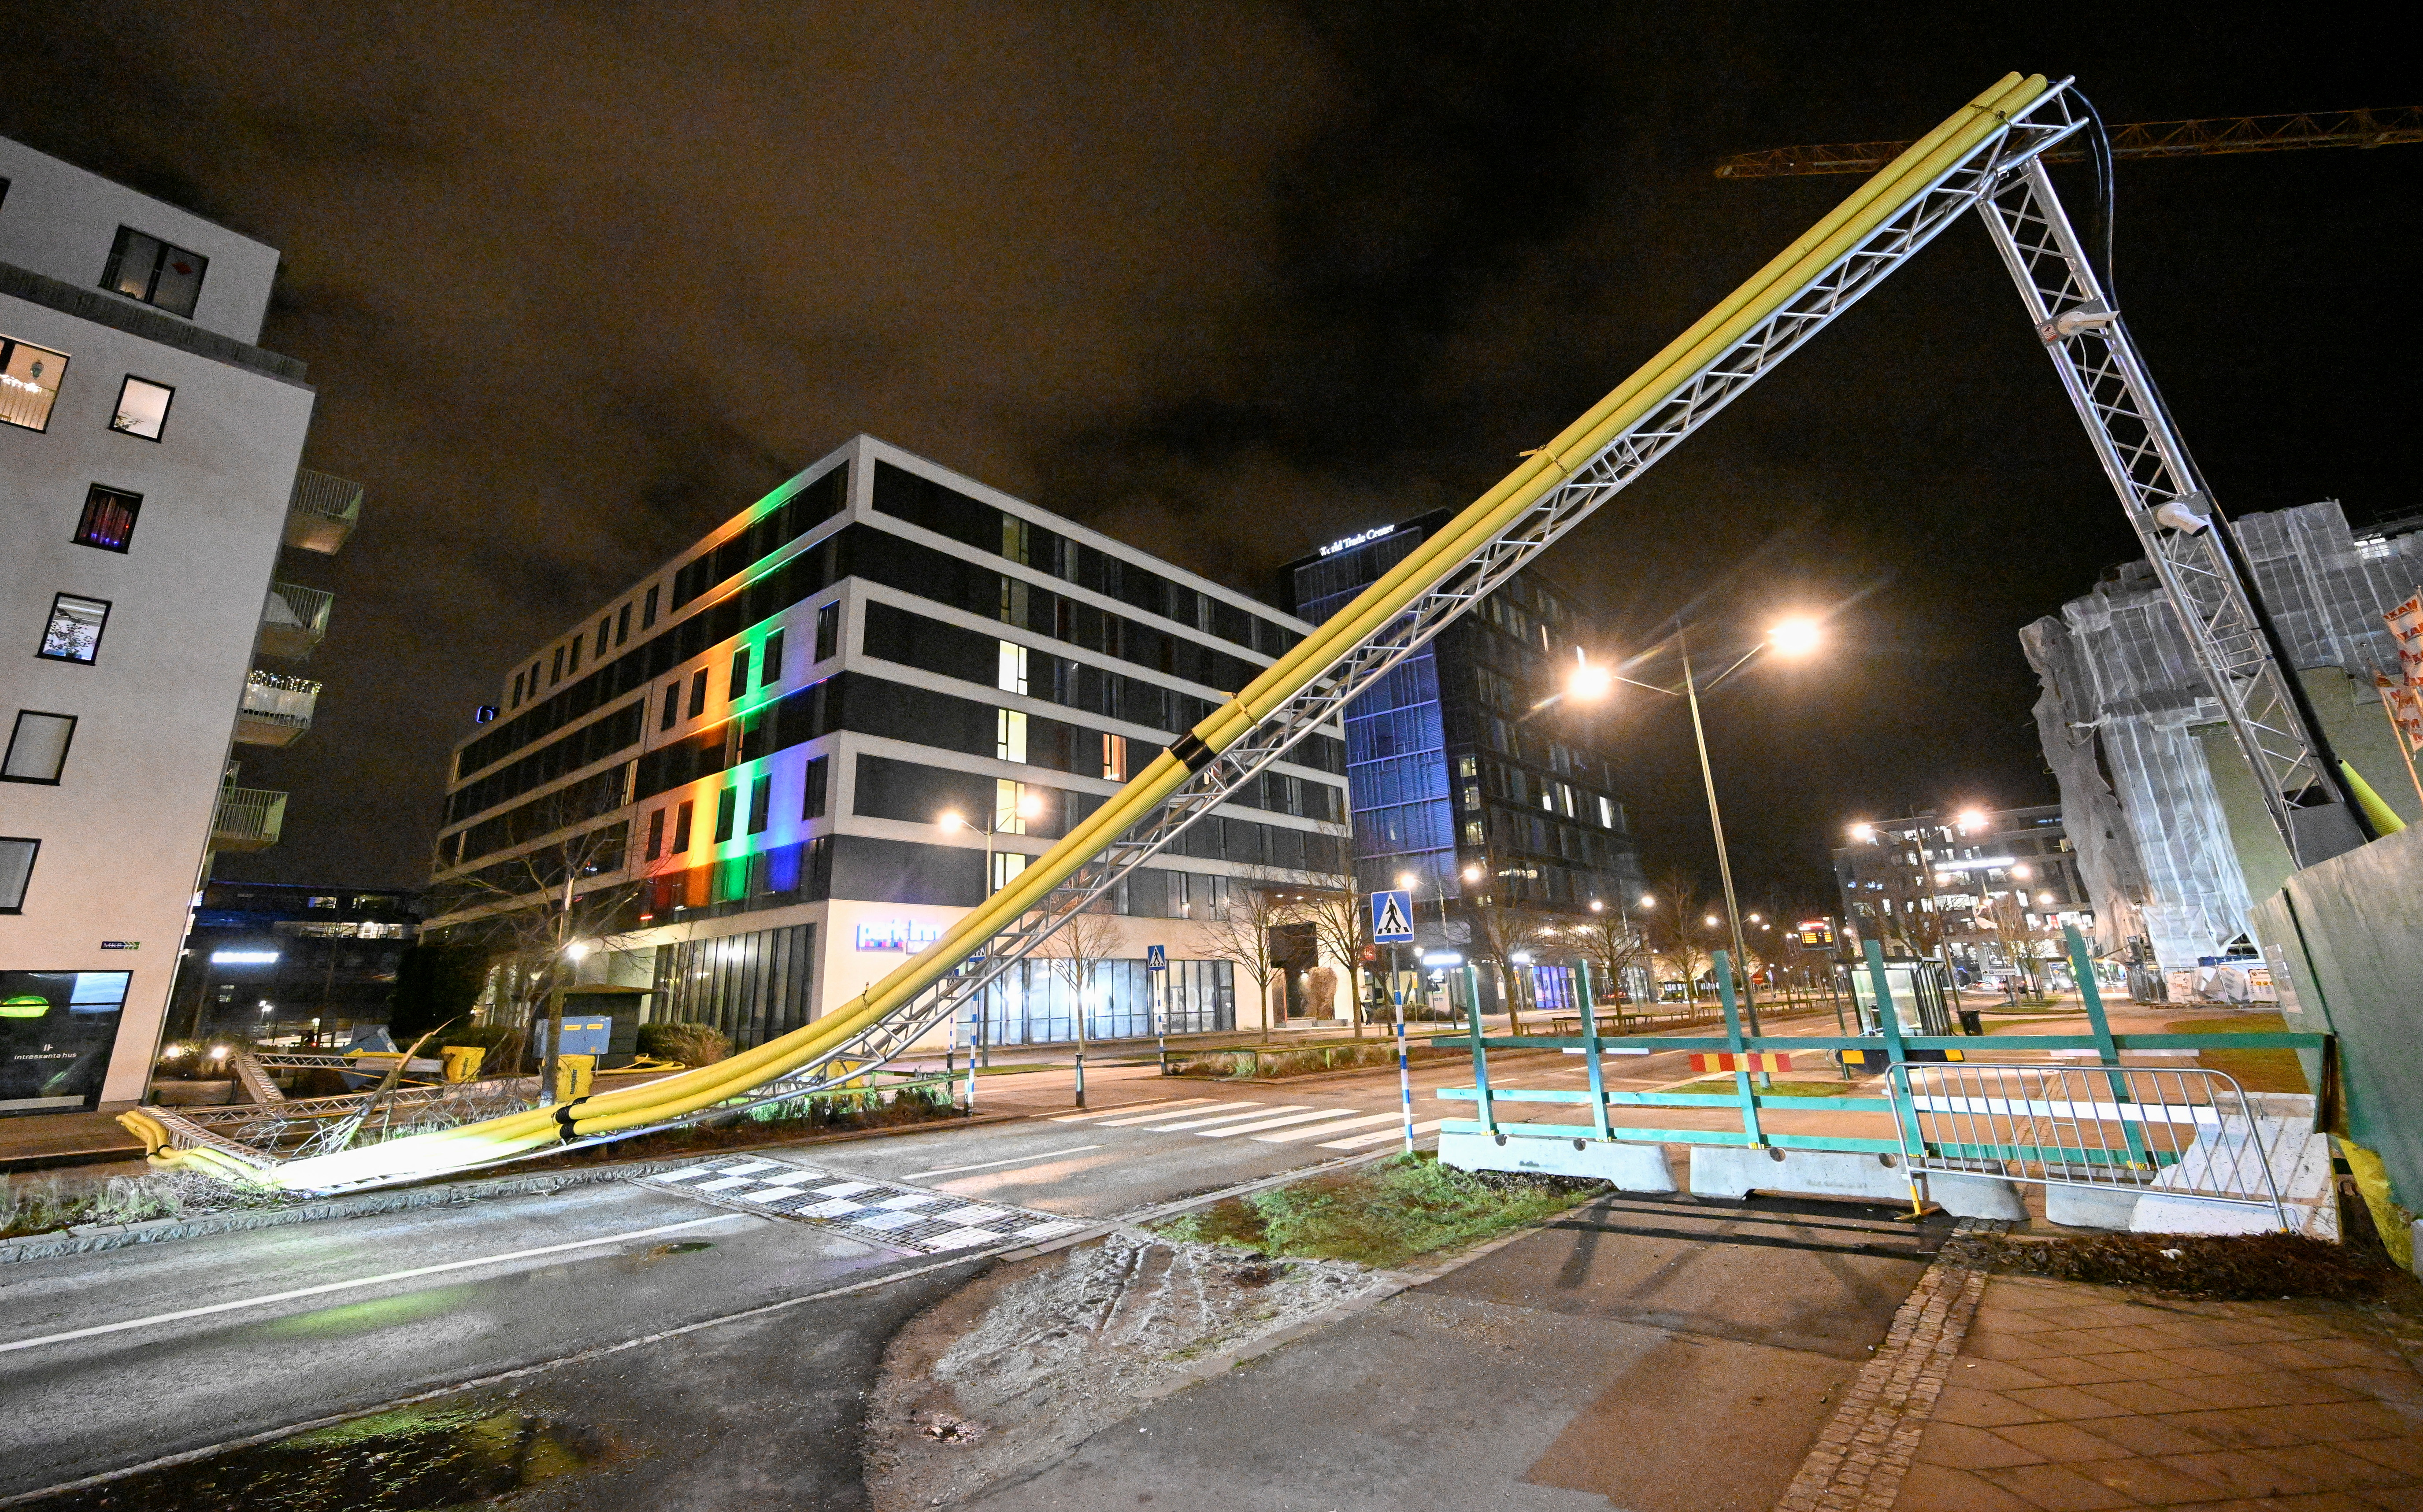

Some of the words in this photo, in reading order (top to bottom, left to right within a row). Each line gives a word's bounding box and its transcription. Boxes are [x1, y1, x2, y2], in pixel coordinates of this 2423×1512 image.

[1319, 540, 1343, 556] World
[1343, 533, 1366, 548] Trade
[1366, 524, 1395, 540] Center
